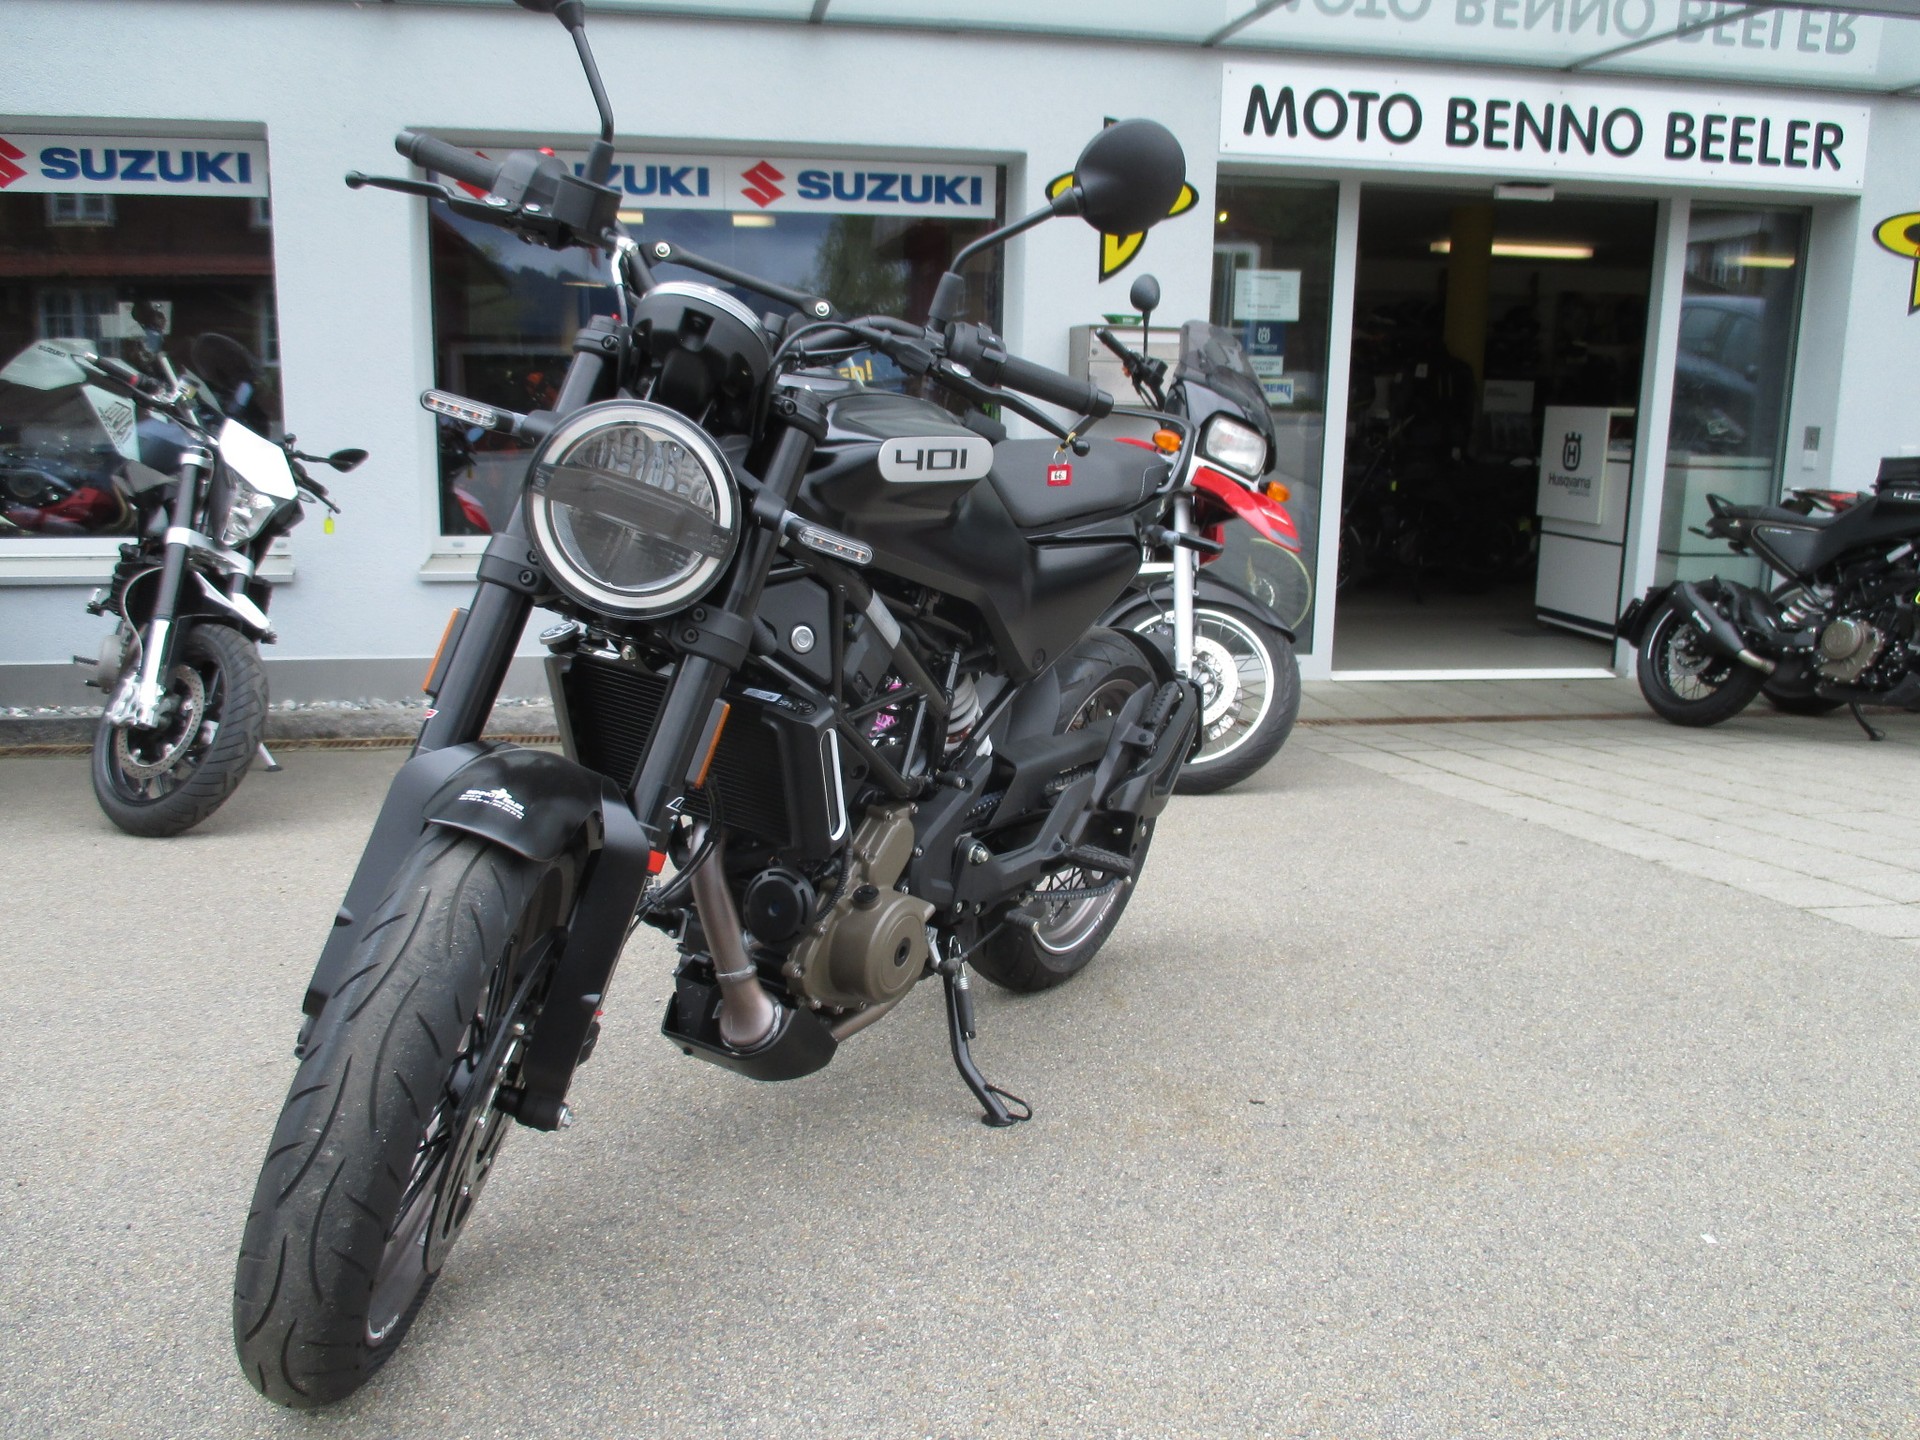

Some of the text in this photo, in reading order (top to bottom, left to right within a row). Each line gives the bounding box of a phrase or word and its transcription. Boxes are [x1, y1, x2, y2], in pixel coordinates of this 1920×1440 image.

[1243, 84, 1844, 171] MOTO BENNO BEELER
[40, 146, 252, 184] SUZUKI
[797, 169, 982, 206] SUZUKI
[895, 448, 967, 470] 401
[1547, 472, 1592, 489] Husqvarna
